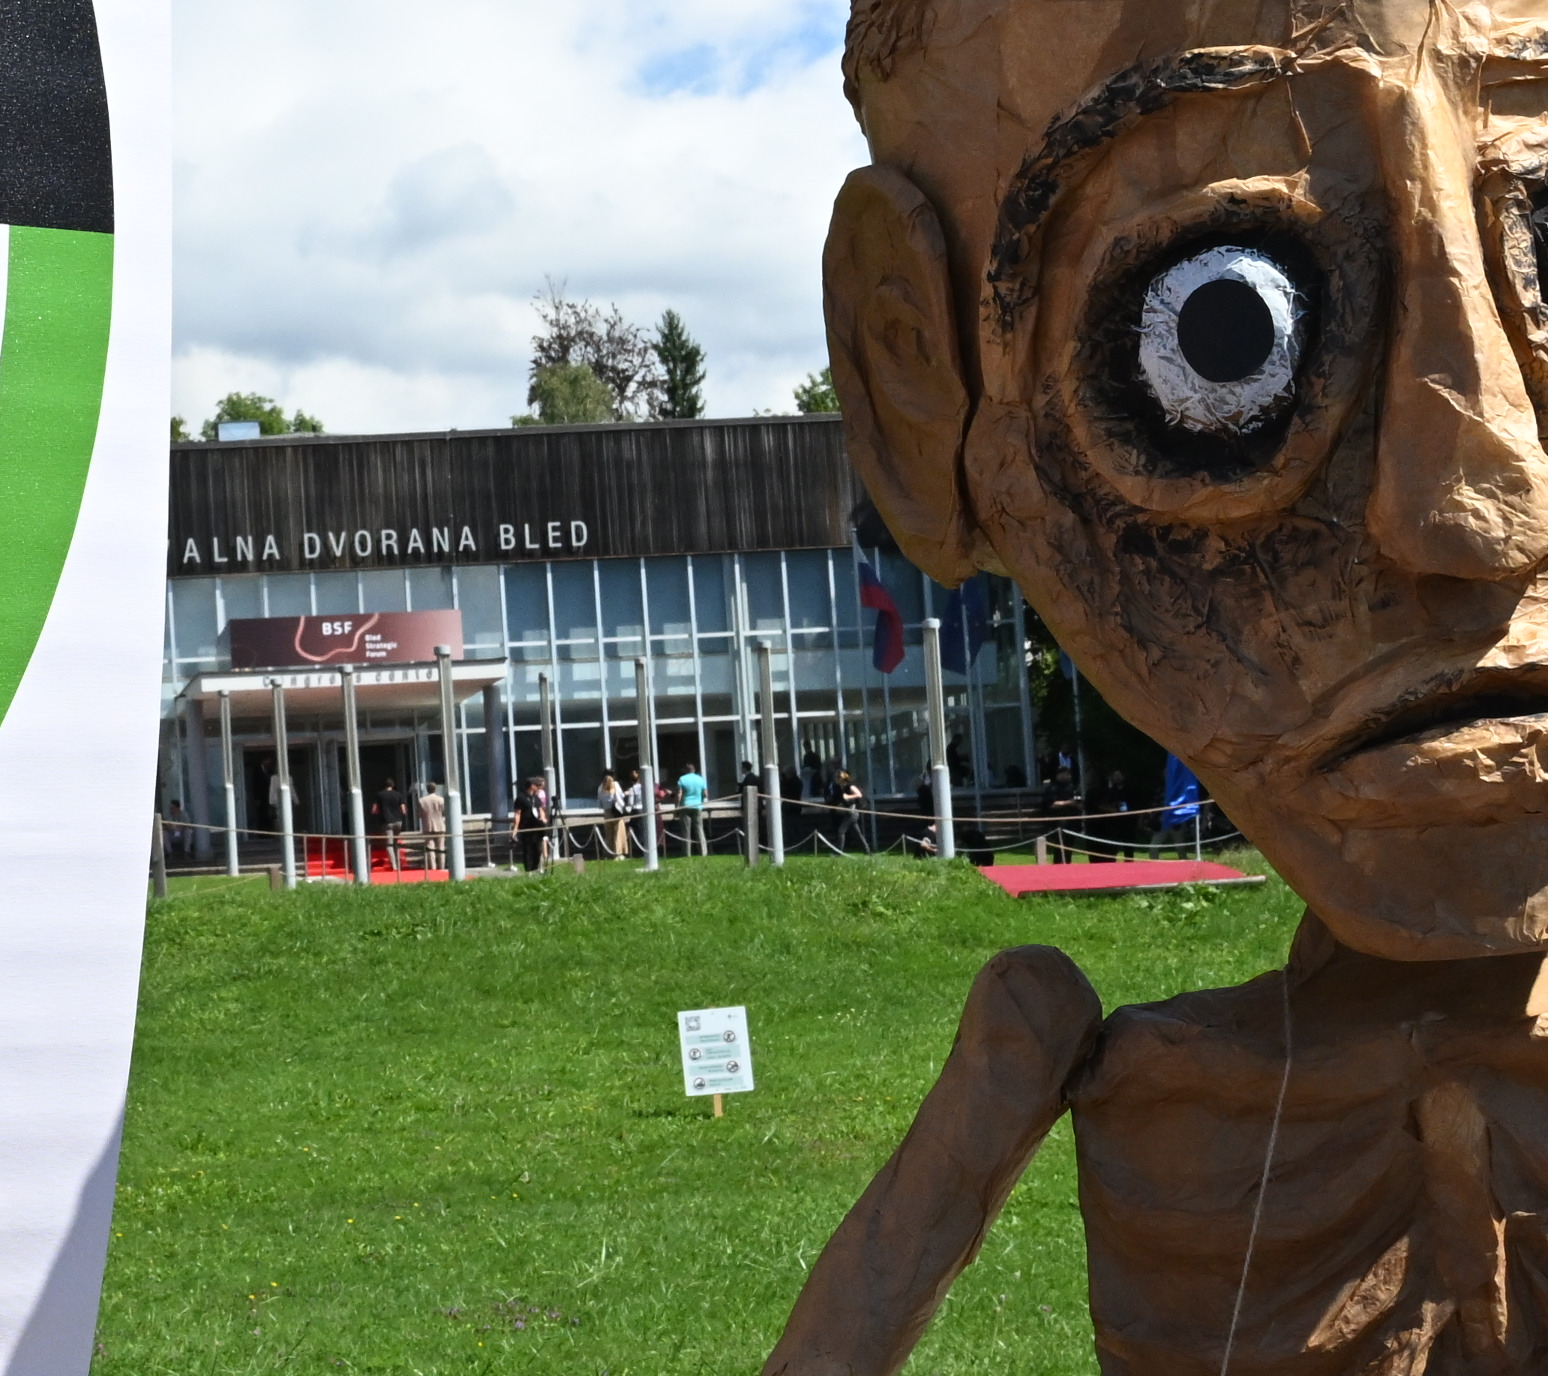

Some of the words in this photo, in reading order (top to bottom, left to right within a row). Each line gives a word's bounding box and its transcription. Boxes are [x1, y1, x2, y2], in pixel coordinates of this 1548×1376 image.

[167, 534, 280, 564] ALNA
[304, 526, 477, 559] DVORANA
[499, 520, 589, 551] BLED
[322, 622, 353, 635] BSF
[365, 642, 397, 650] Strategic
